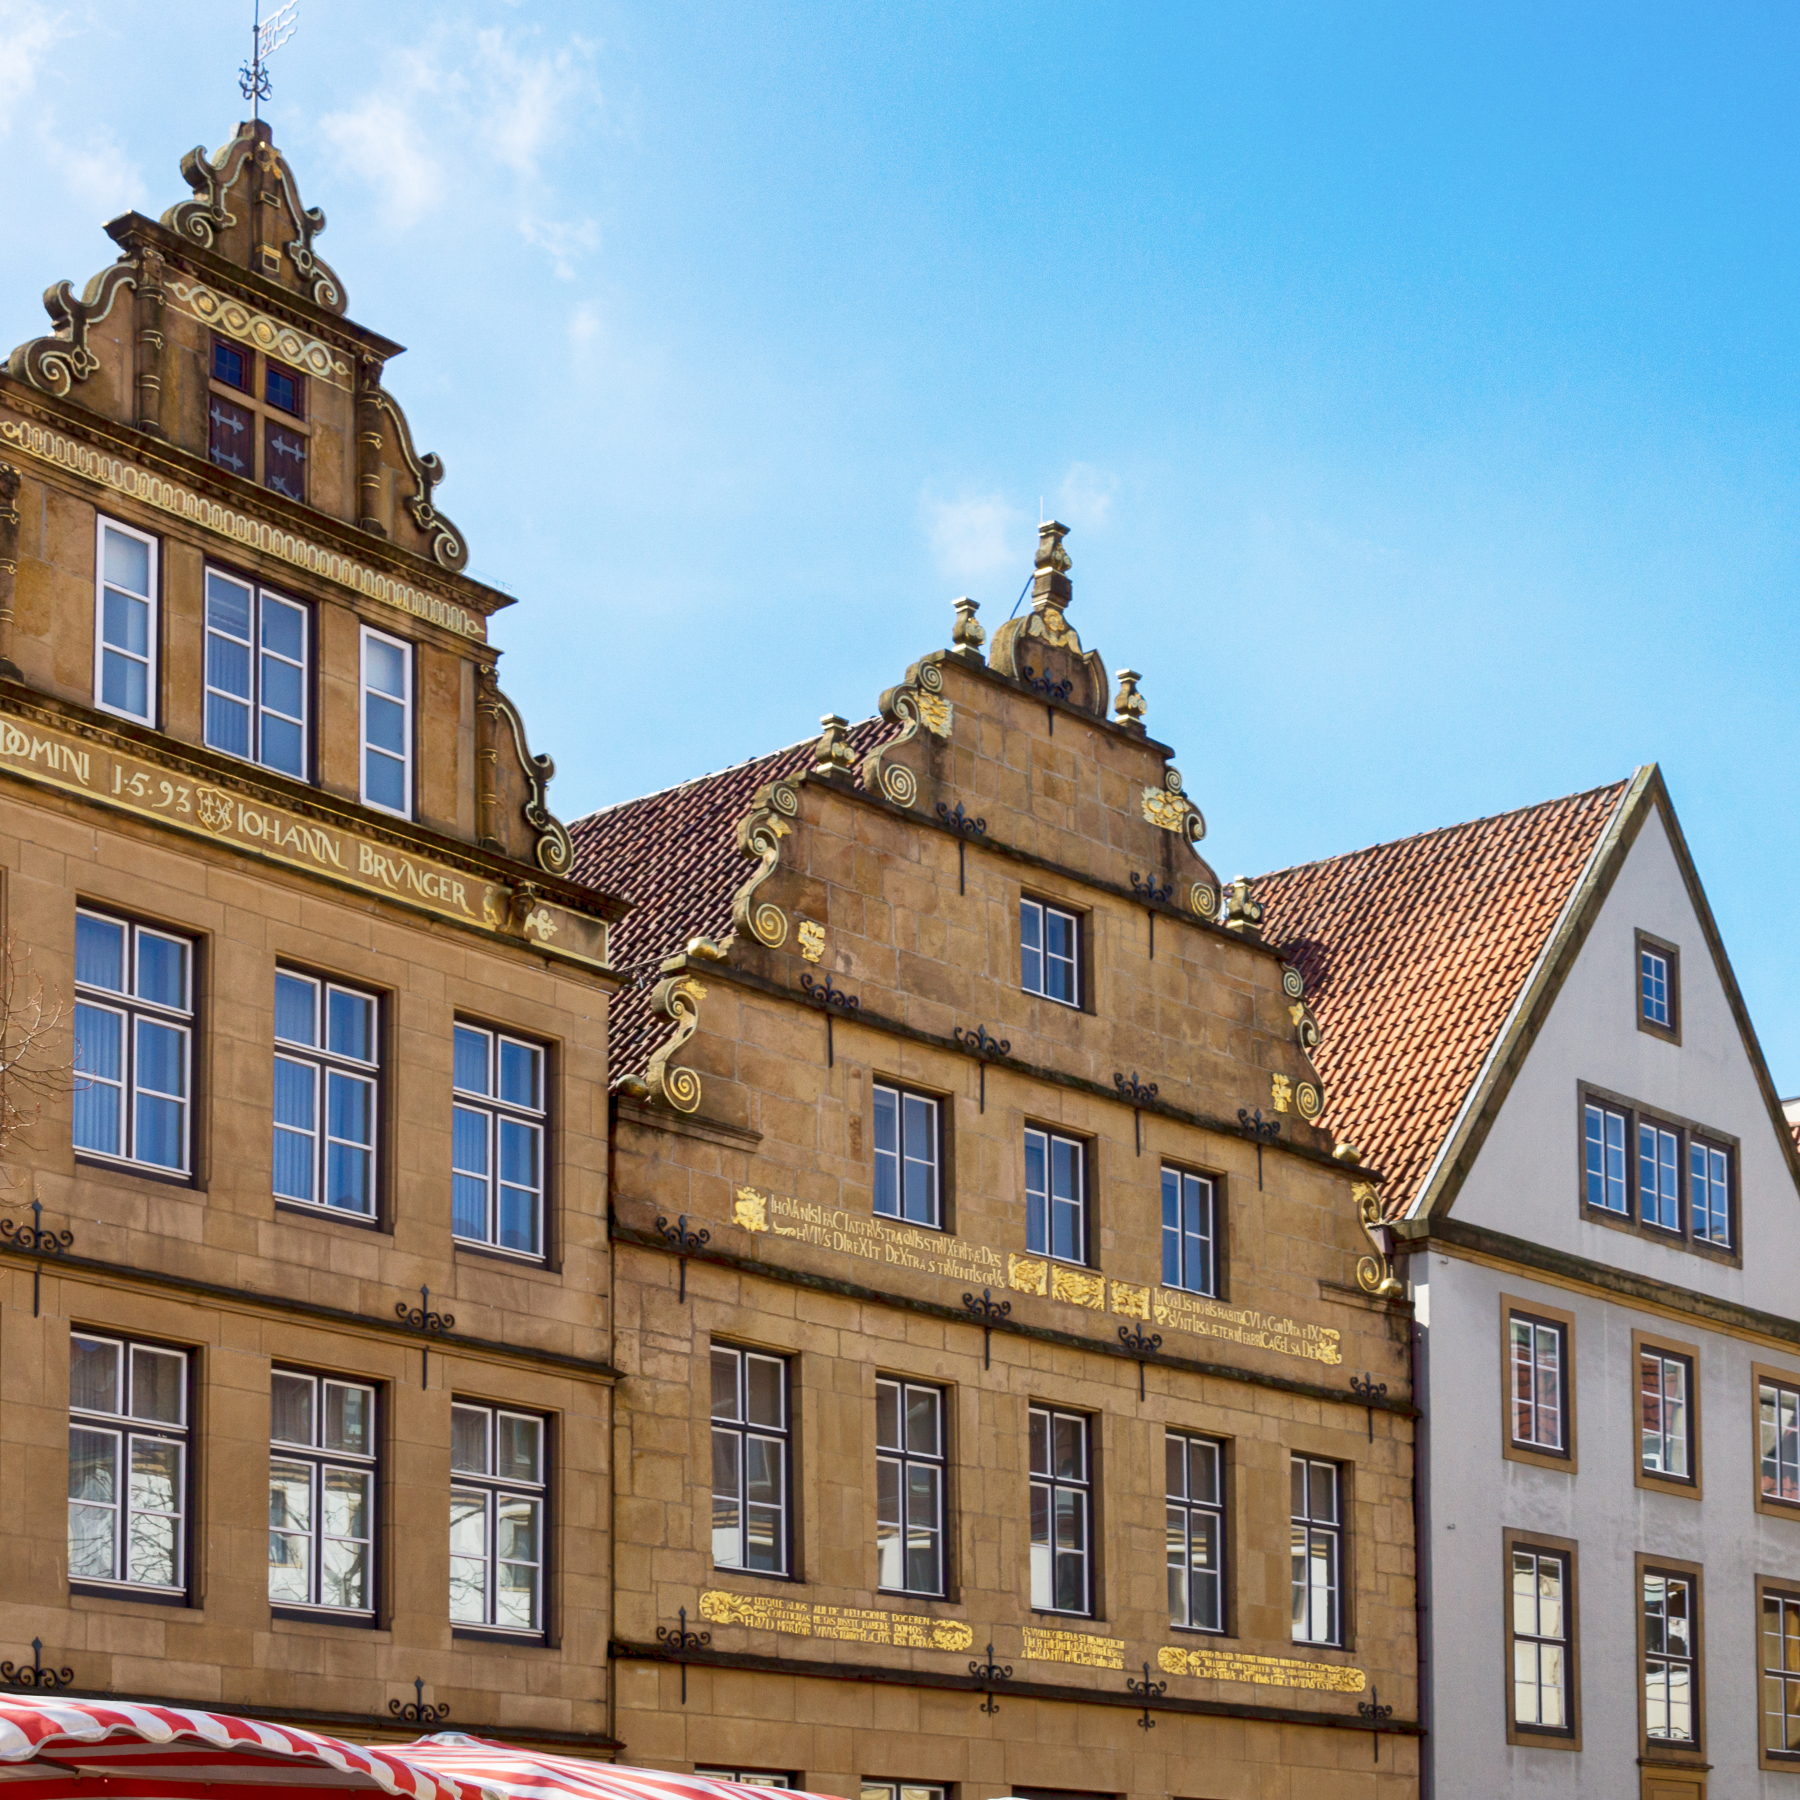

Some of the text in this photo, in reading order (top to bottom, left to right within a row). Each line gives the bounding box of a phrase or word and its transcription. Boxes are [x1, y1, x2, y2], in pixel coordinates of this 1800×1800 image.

[0, 720, 91, 786] DOMINI
[237, 803, 349, 871] IOHANN
[358, 843, 477, 917] BRVNGER
